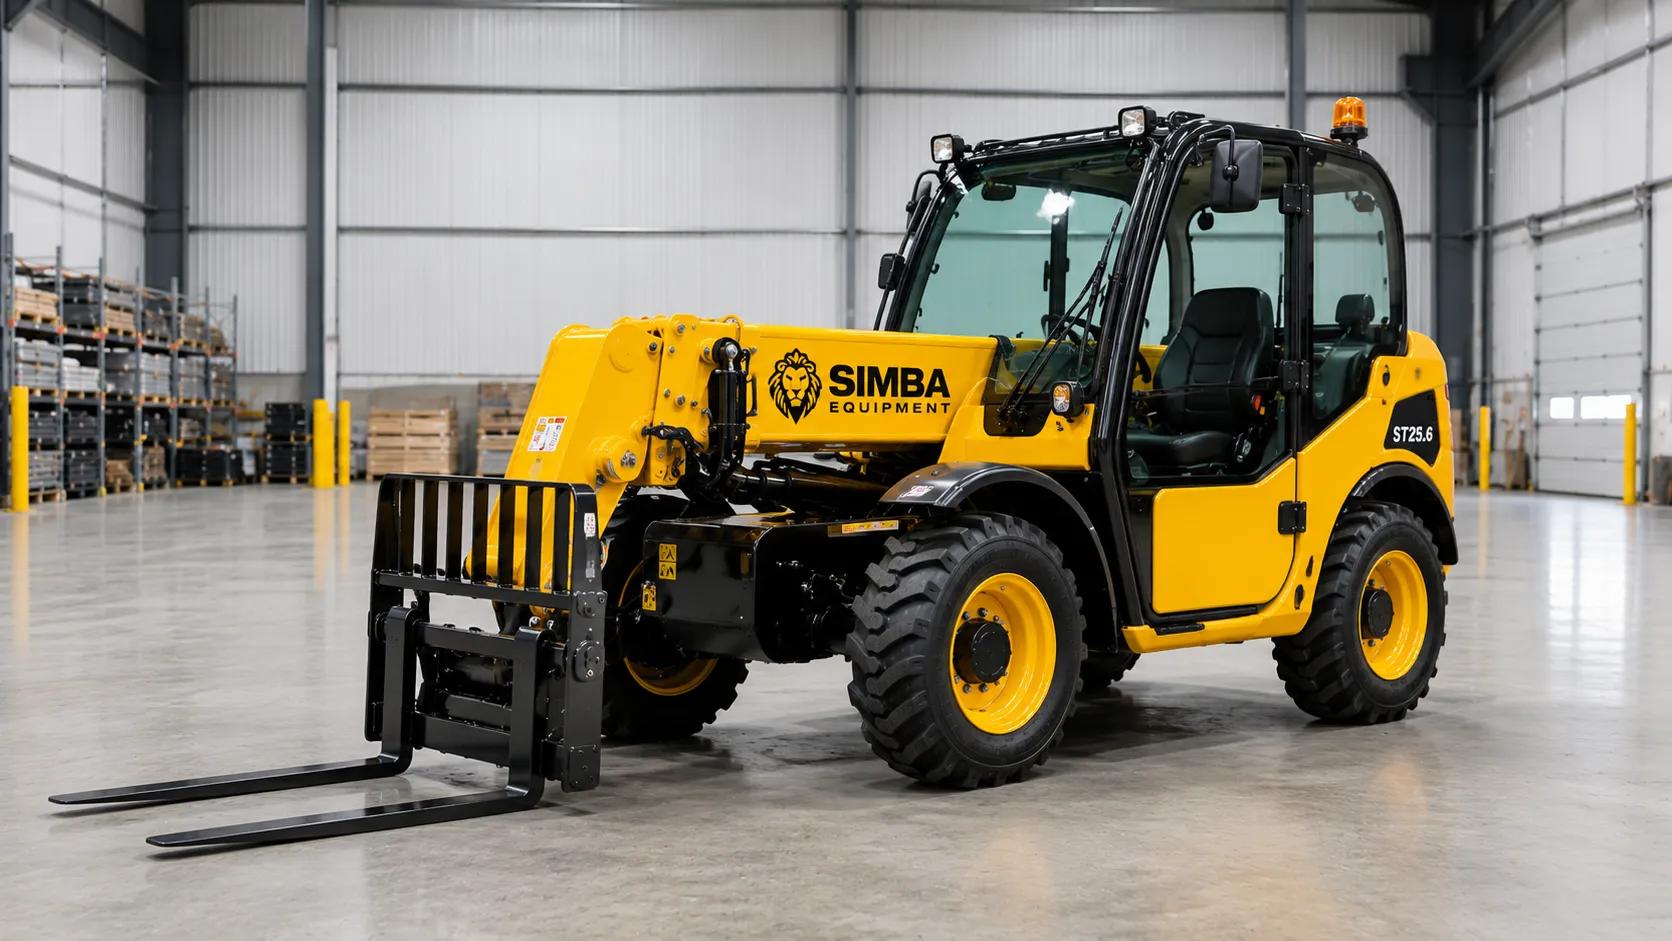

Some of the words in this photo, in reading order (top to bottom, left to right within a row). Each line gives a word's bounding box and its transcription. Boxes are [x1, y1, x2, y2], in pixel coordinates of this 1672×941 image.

[829, 364, 951, 398] SIMBA
[829, 401, 951, 414] EQUIPMENT
[1393, 426, 1433, 443] ST25.6
